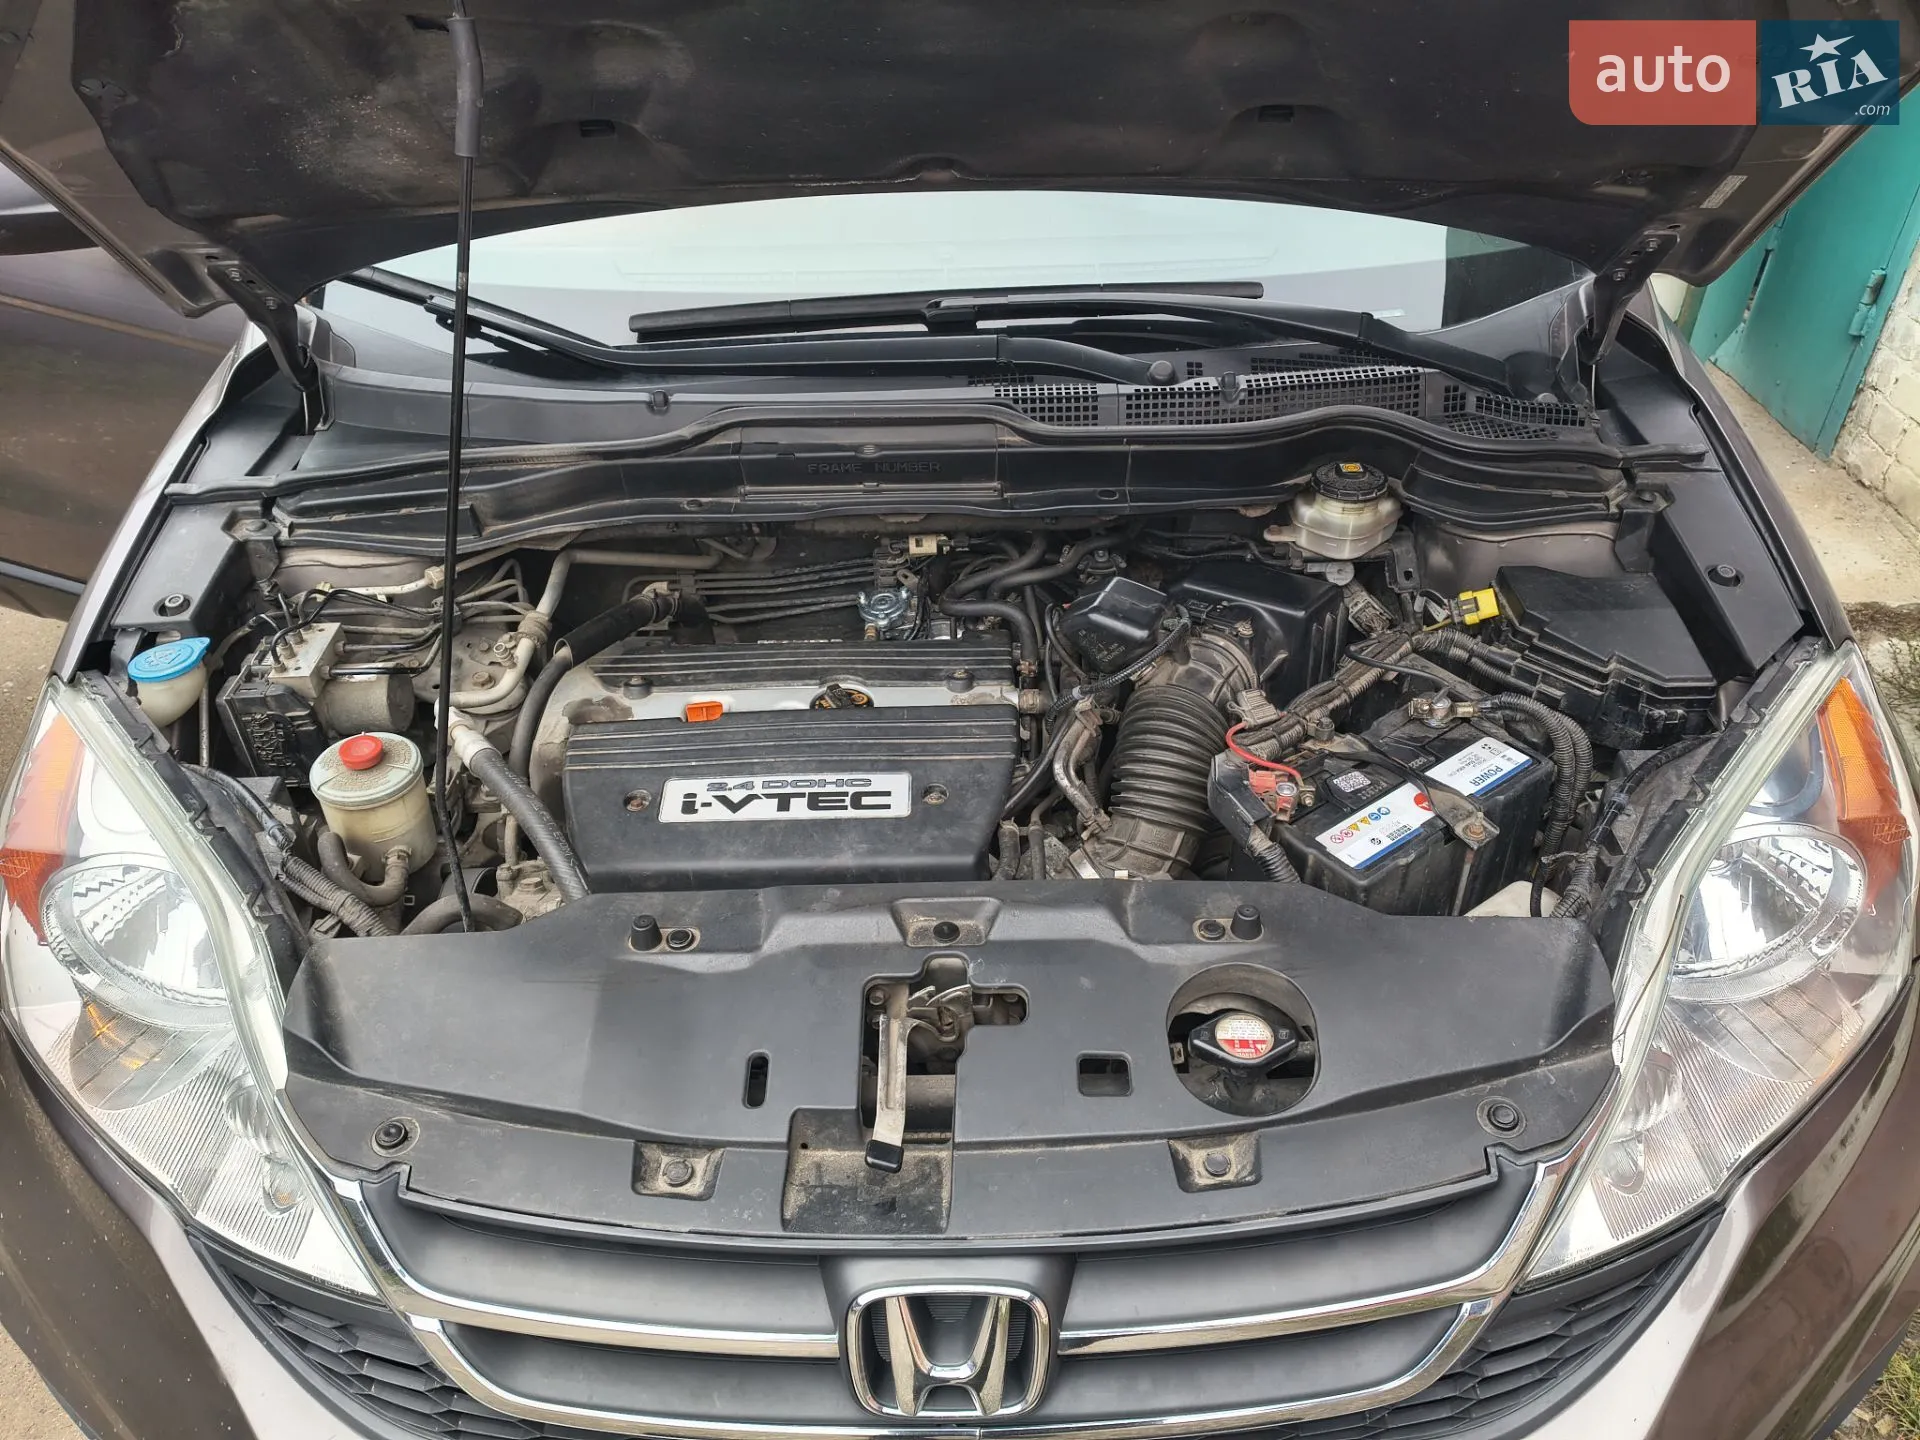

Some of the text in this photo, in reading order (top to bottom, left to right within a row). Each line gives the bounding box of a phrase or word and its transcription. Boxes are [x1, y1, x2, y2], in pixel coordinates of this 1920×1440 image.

[806, 461, 942, 474] FRAME NUMBER
[706, 778, 872, 792] 2.4 DOHC
[1469, 765, 1504, 787] POWER
[680, 790, 892, 816] i-VTEC
